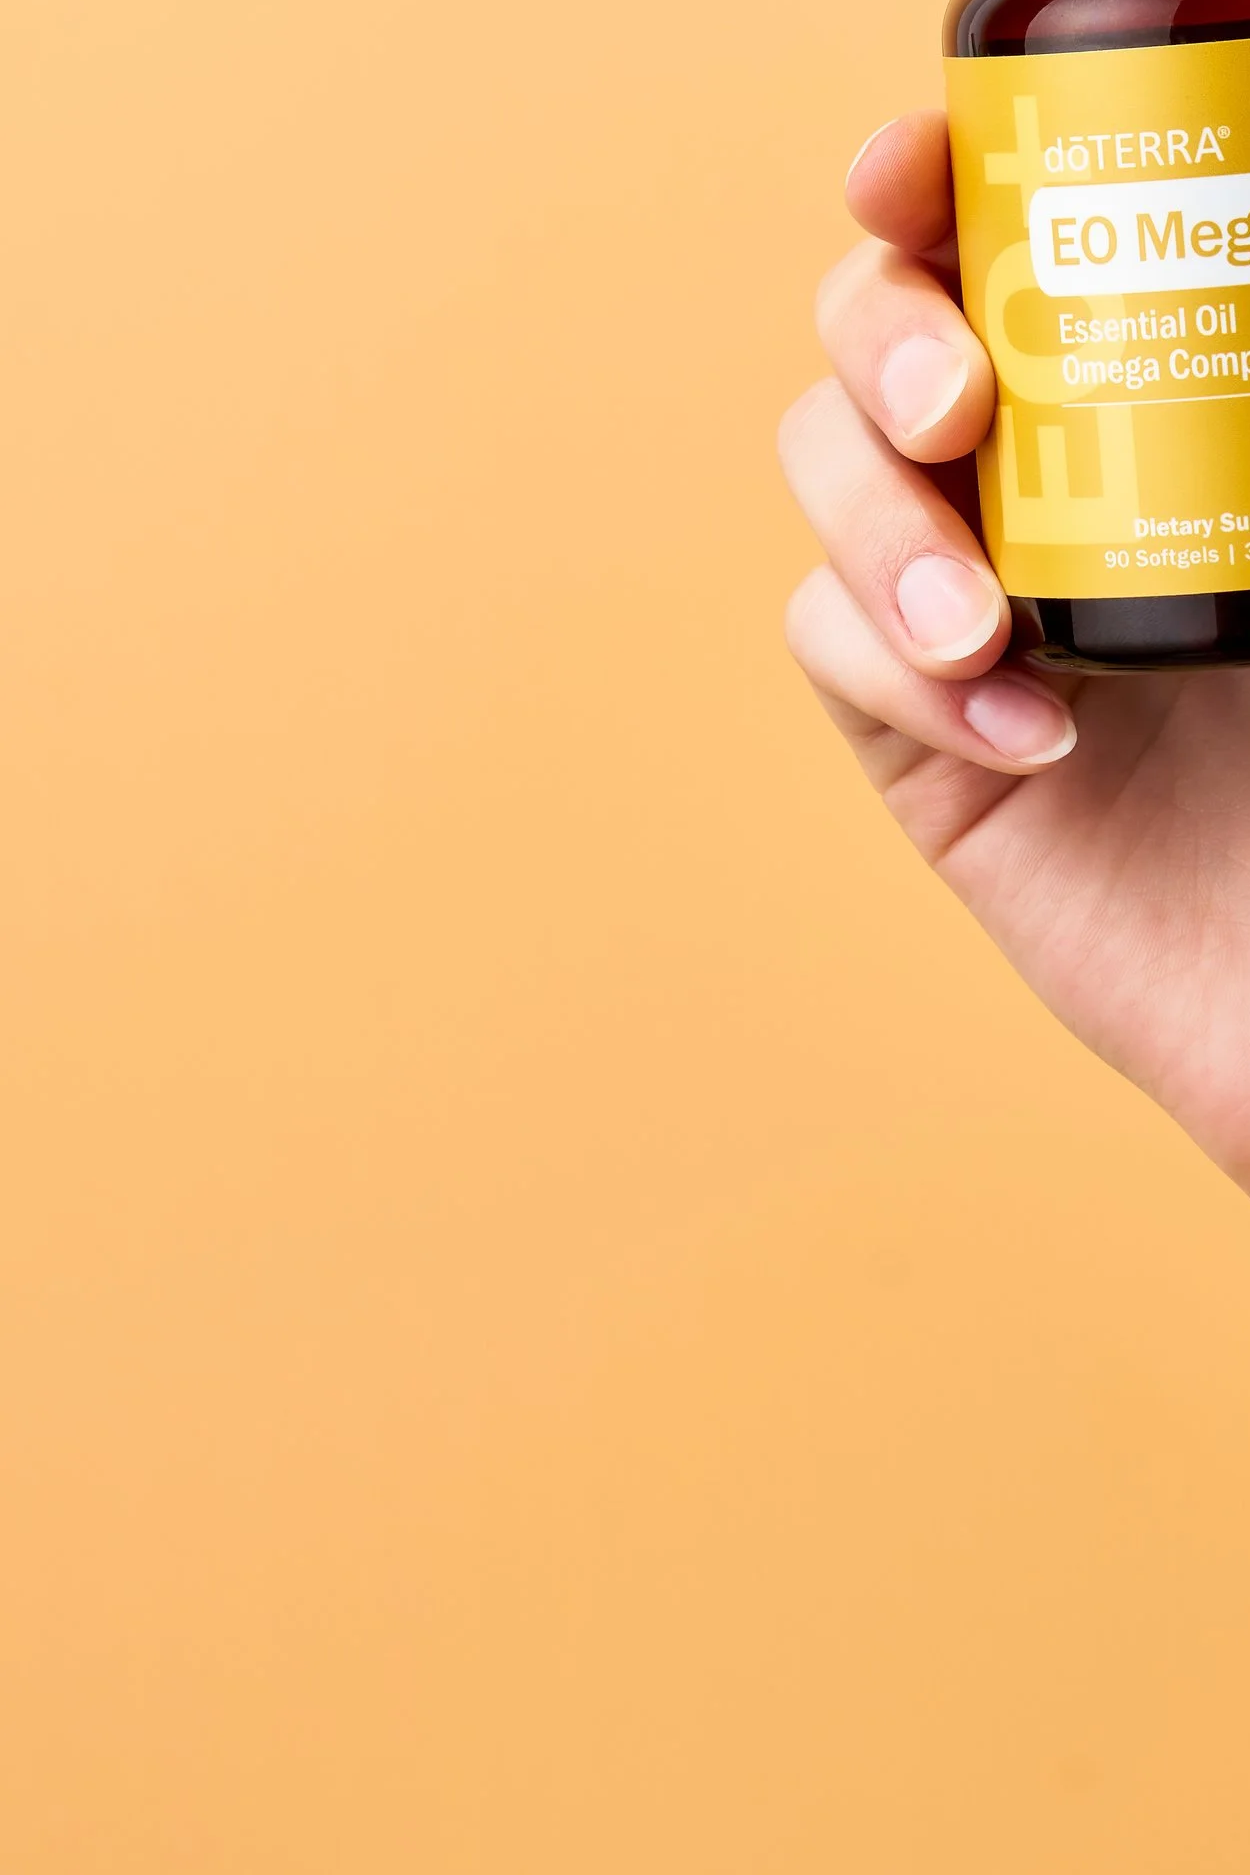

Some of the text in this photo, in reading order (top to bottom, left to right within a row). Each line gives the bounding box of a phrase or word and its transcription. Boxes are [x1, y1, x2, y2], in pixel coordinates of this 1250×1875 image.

[1050, 215, 1118, 267] EO
[1058, 303, 1237, 345] Essential Oil
[1061, 354, 1161, 390] Omega
[1133, 517, 1214, 539] Dietary
[1104, 549, 1130, 569] 90
[1135, 545, 1220, 570] Softgels
